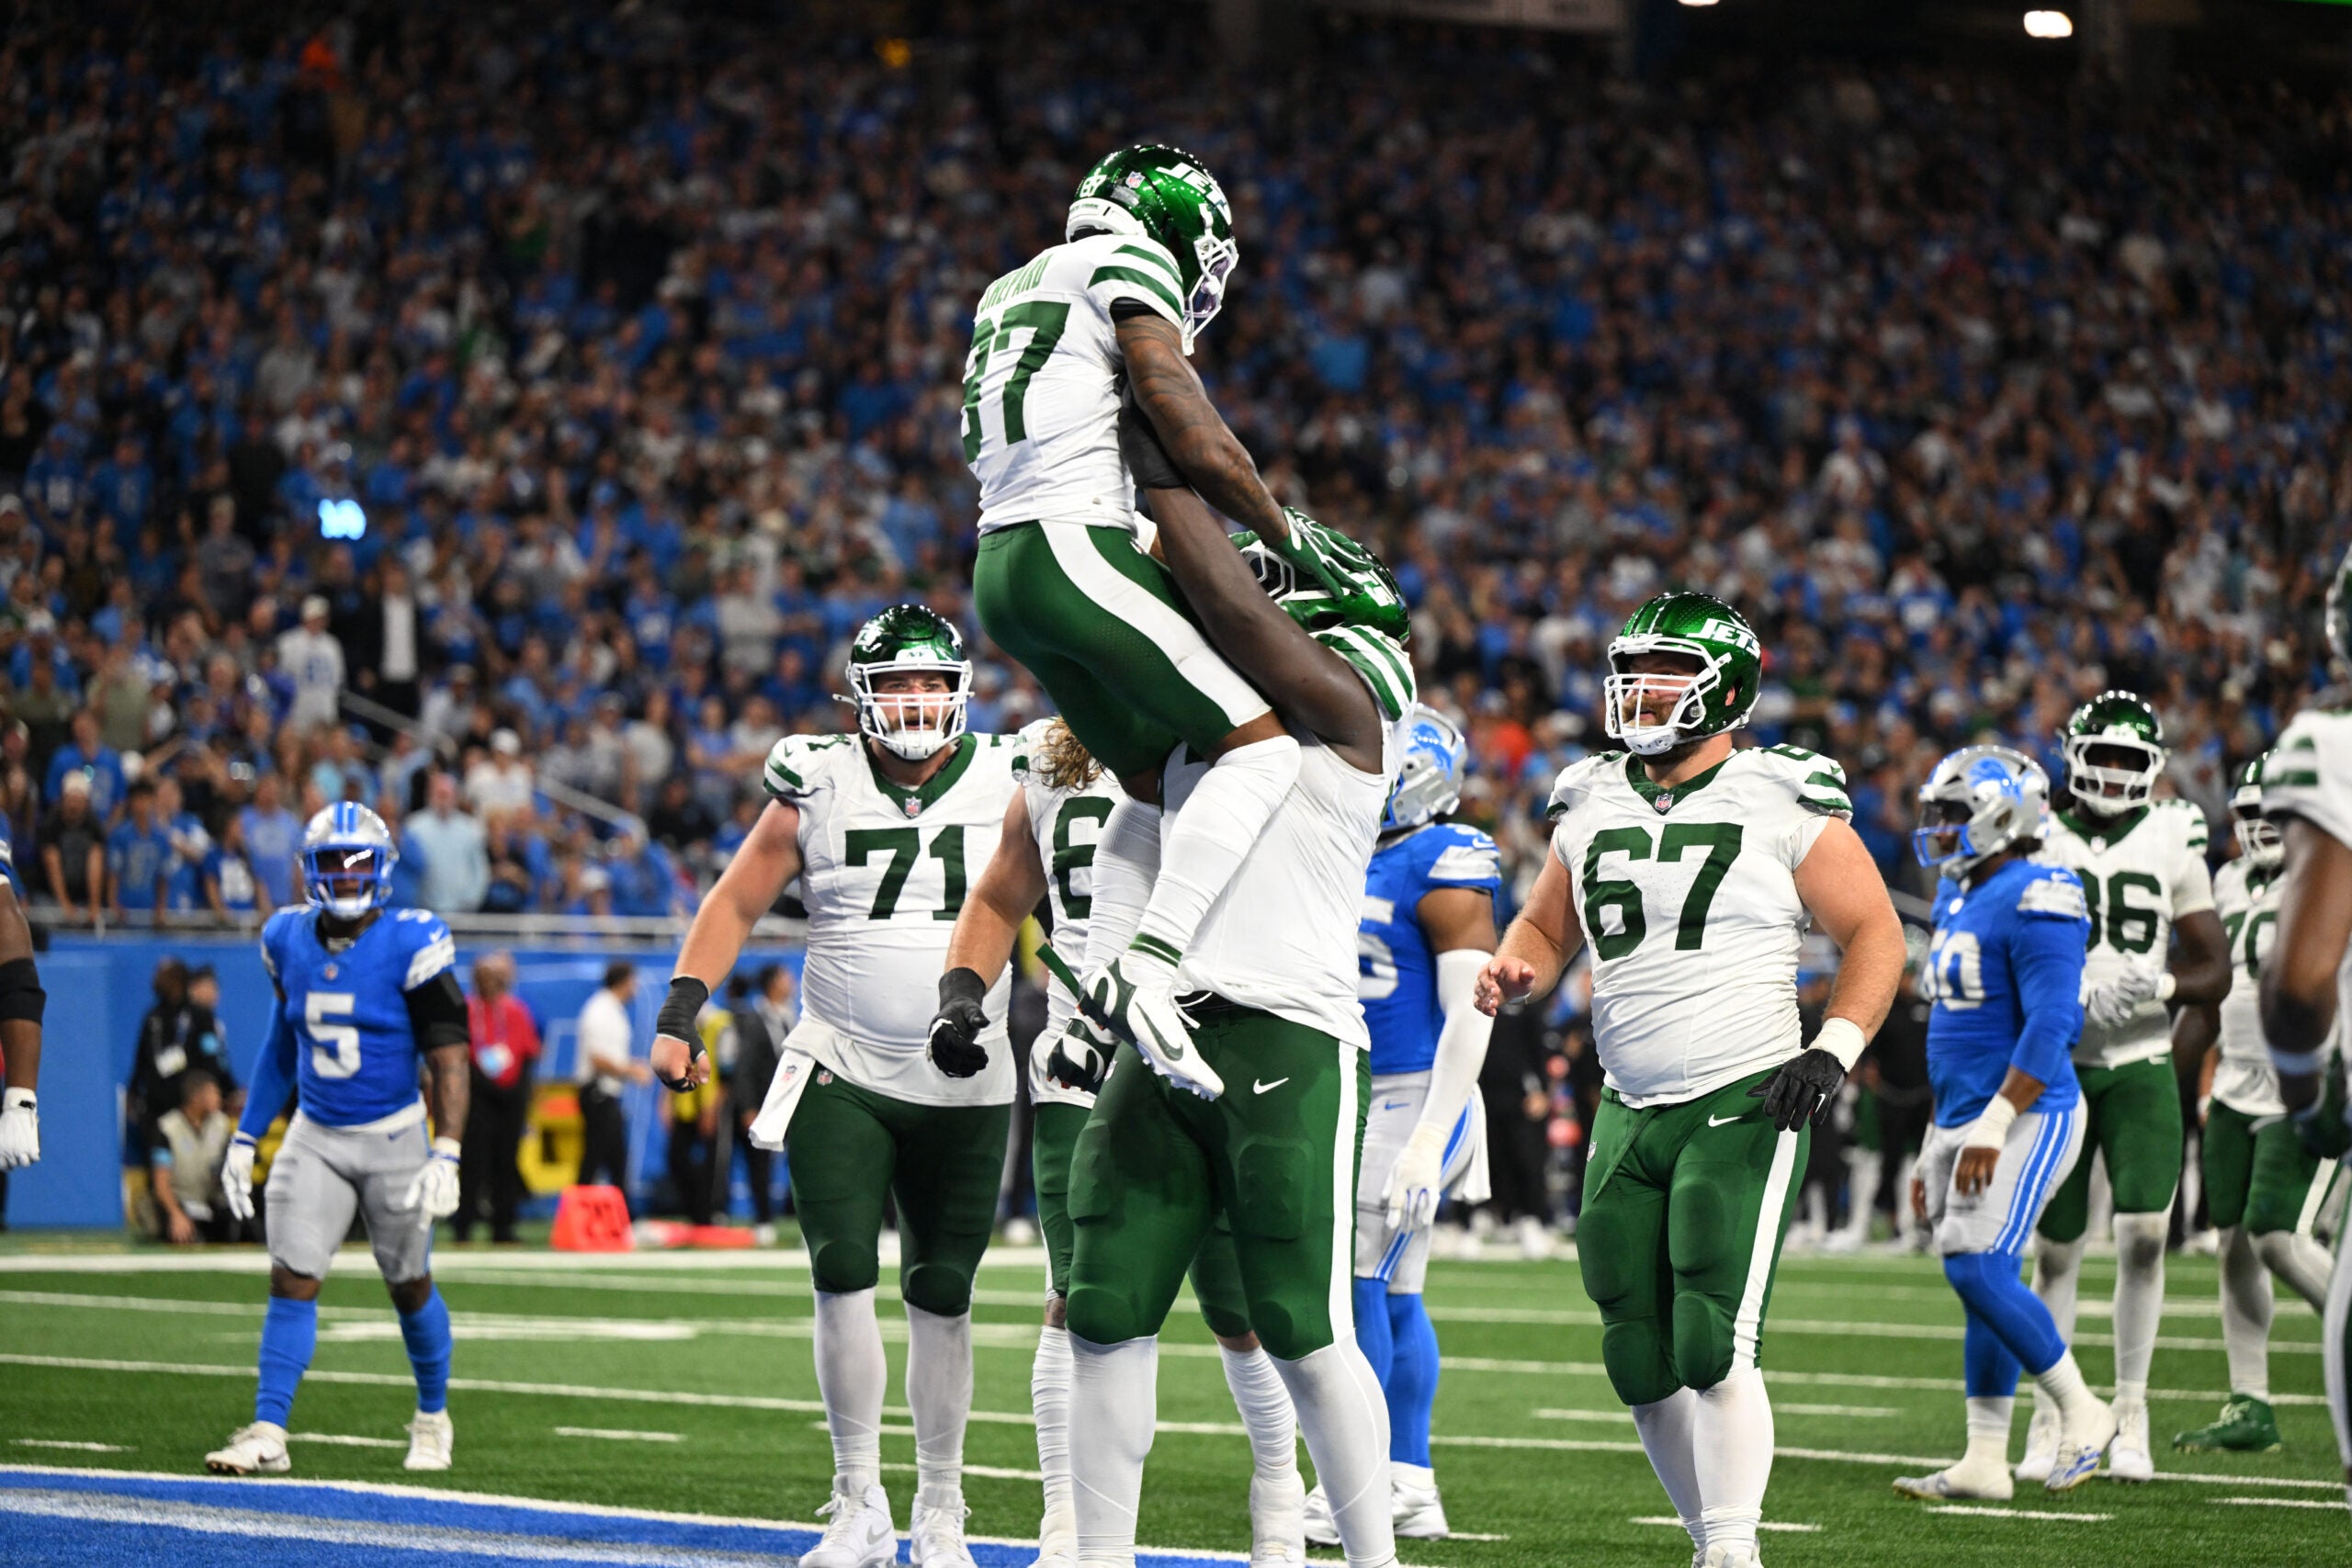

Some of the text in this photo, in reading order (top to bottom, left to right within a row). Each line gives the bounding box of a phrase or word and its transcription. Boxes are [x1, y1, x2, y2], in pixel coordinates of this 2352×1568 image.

[1687, 617, 1761, 660] JETS
[845, 826, 967, 920] 71
[1582, 822, 1744, 962] 67
[305, 992, 361, 1078] 5
